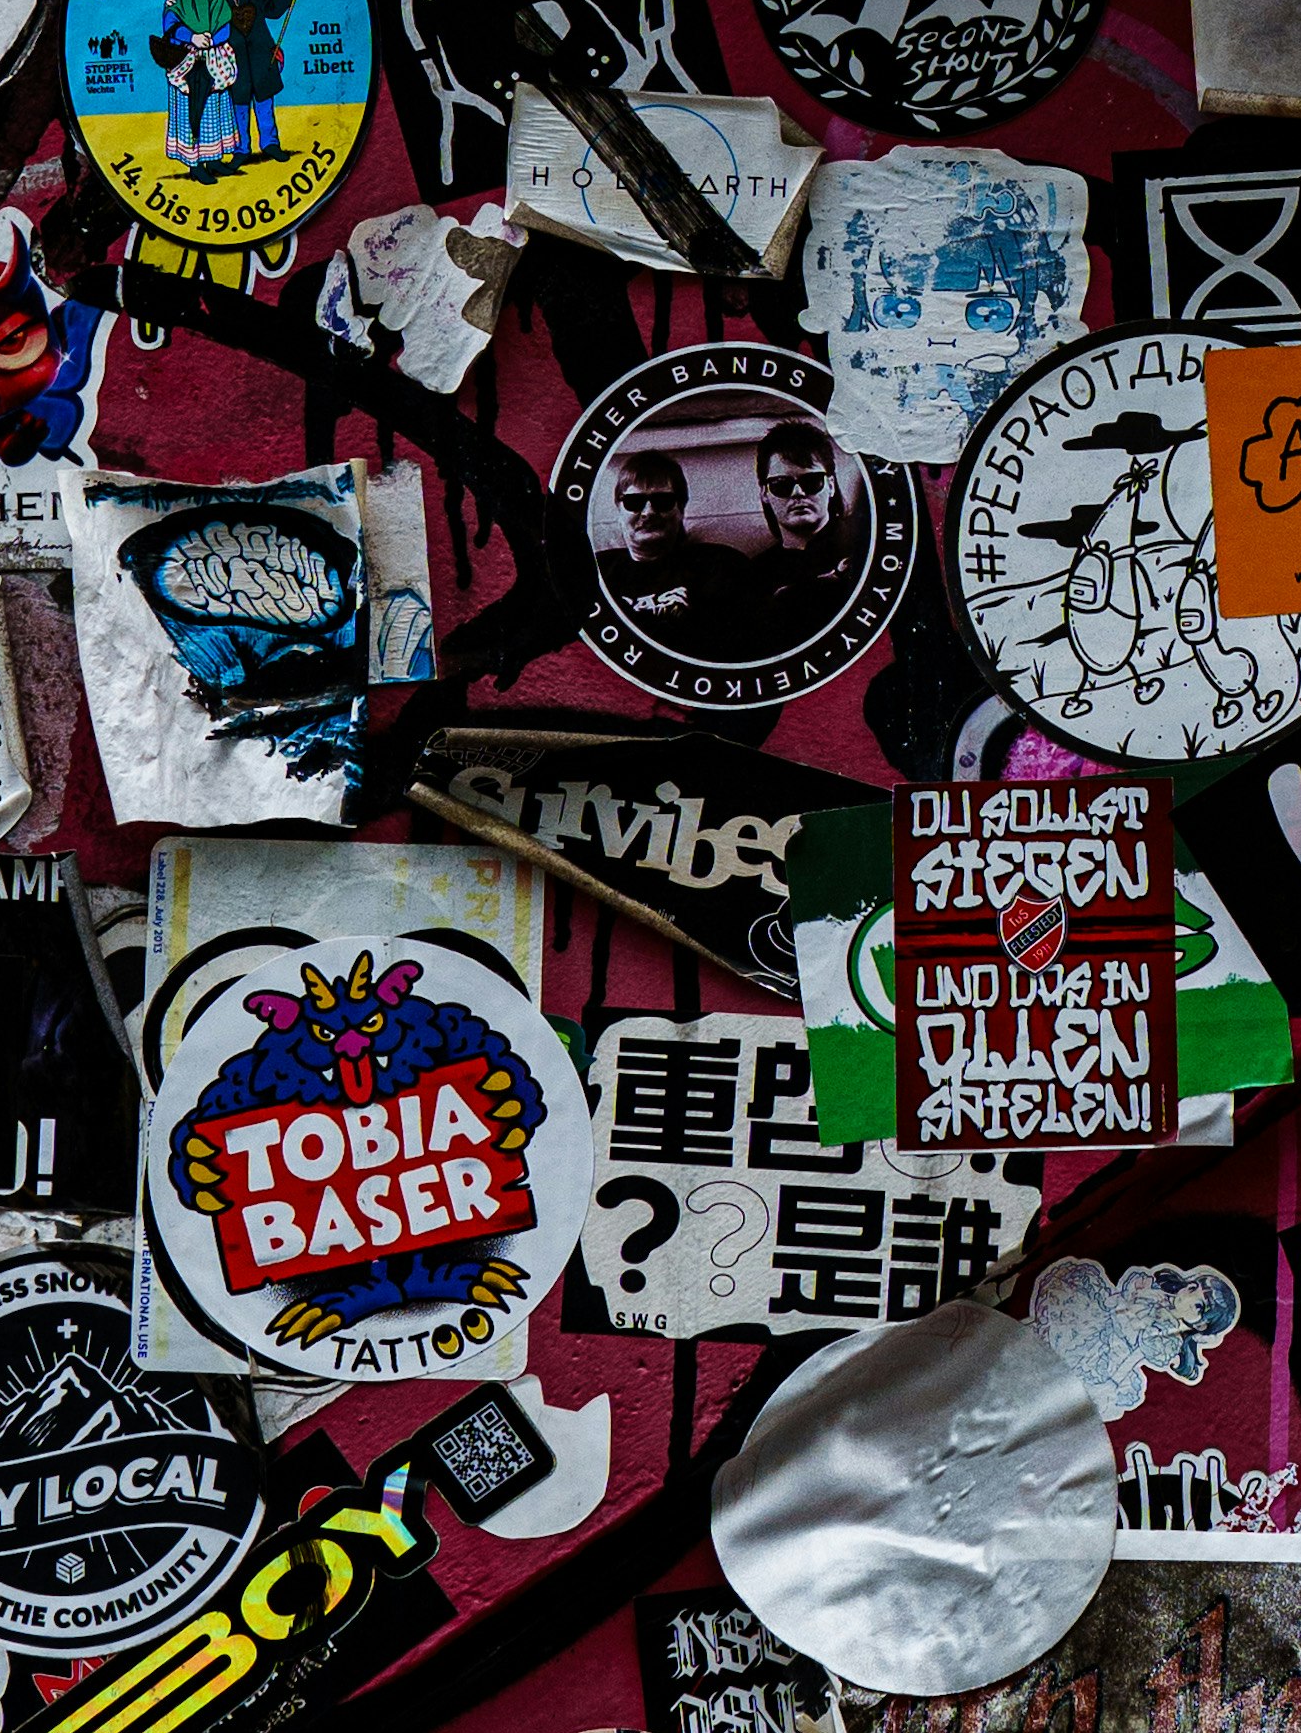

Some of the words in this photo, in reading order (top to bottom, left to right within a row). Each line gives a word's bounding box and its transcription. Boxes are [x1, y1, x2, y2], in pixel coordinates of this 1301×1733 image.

[309, 18, 343, 38] Jan
[309, 38, 344, 57] und
[302, 57, 356, 76] Libett
[109, 151, 142, 193] 14.
[142, 187, 192, 229] bis
[196, 140, 339, 235] 19.08.2025
[566, 386, 648, 504] OTHER
[672, 355, 807, 389] BANDS
[1010, 907, 1064, 958] FLEESTEDT
[1031, 944, 1054, 965] 1911
[224, 1083, 490, 1193] TOBIA
[241, 1157, 501, 1268] BASER
[40, 1456, 229, 1519] LOCAL
[52, 1538, 207, 1628] COMMUNITY
